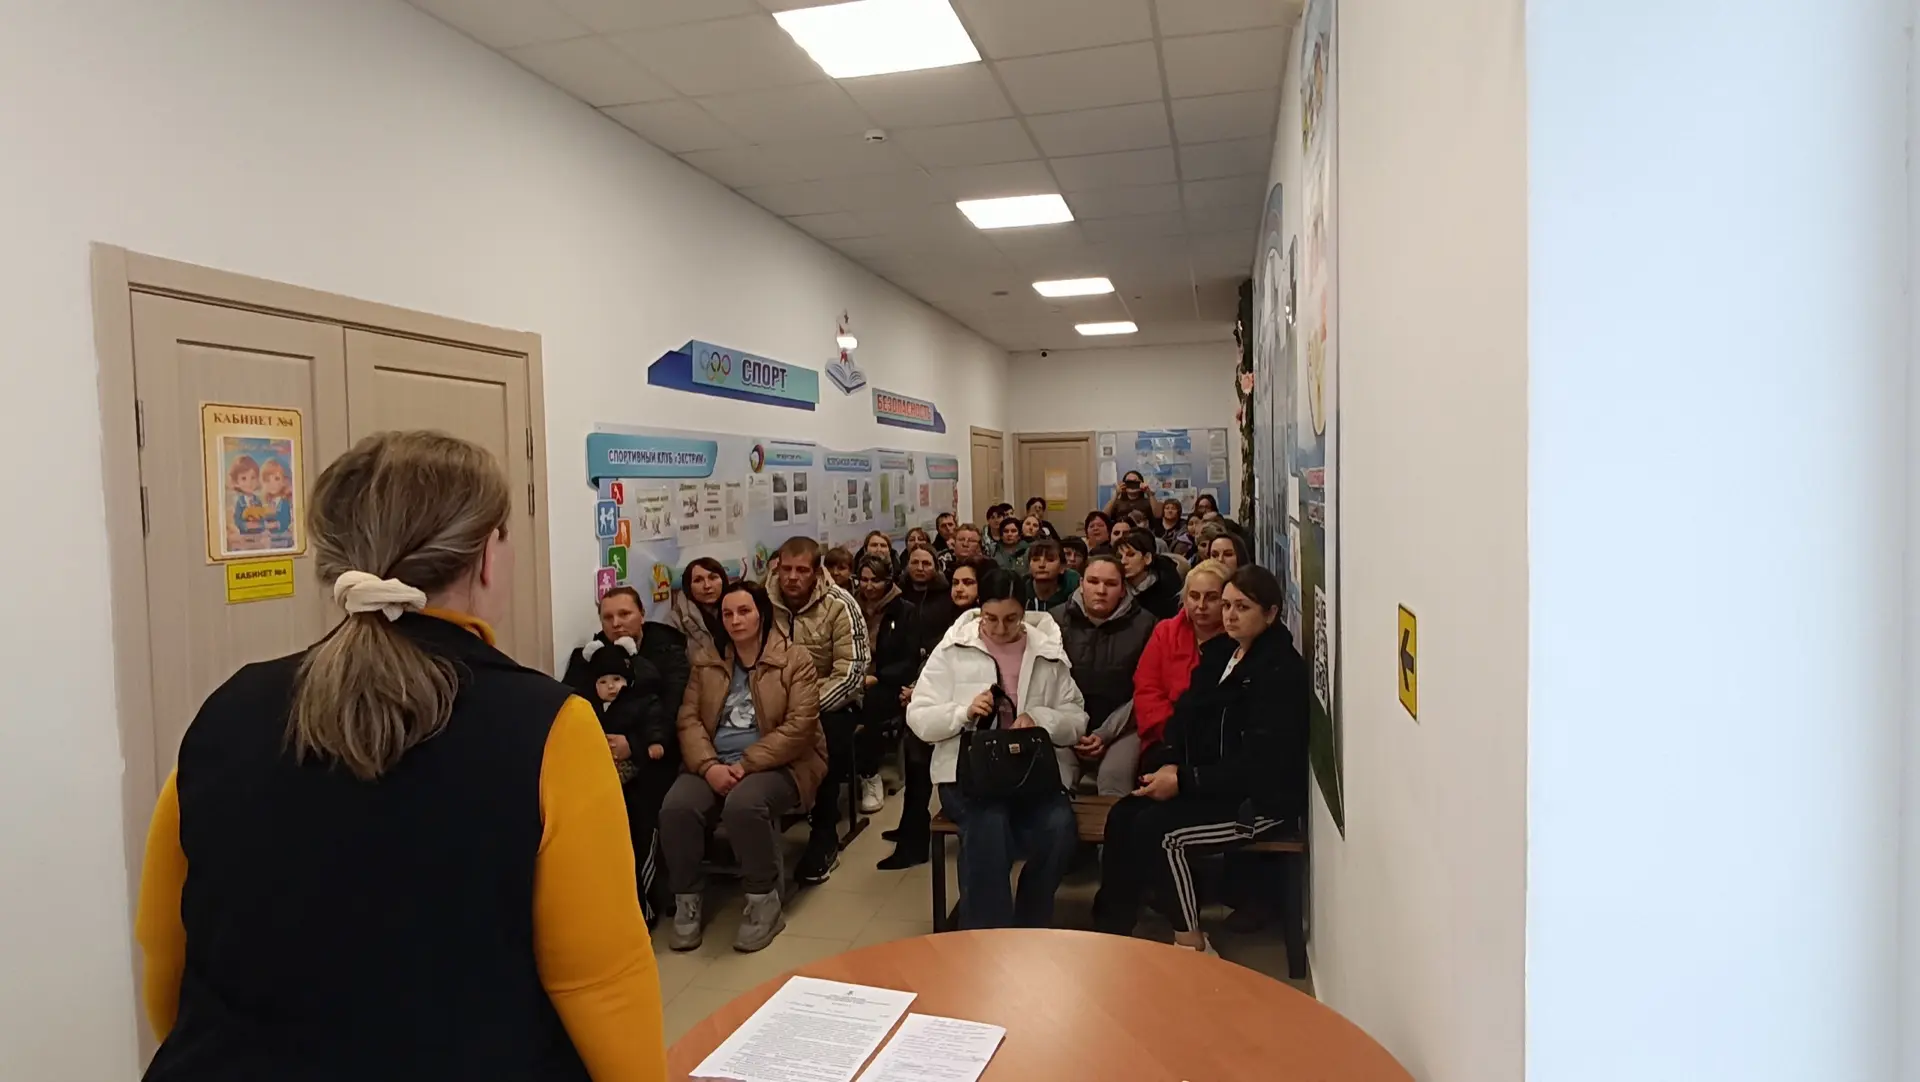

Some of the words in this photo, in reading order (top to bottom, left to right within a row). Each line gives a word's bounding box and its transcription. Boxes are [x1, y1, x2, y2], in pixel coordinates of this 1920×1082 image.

[742, 359, 787, 390] СПОРТ
[877, 394, 931, 419] БЕЗОПАСНОСТЬ
[213, 412, 273, 427] КАБИНЕТ
[277, 416, 294, 428] №4
[609, 449, 656, 464] СПОРТИВНЫЙ
[657, 451, 673, 465] КЛУБ
[235, 569, 273, 581] КАБИНЕТ
[274, 568, 288, 578] №4
